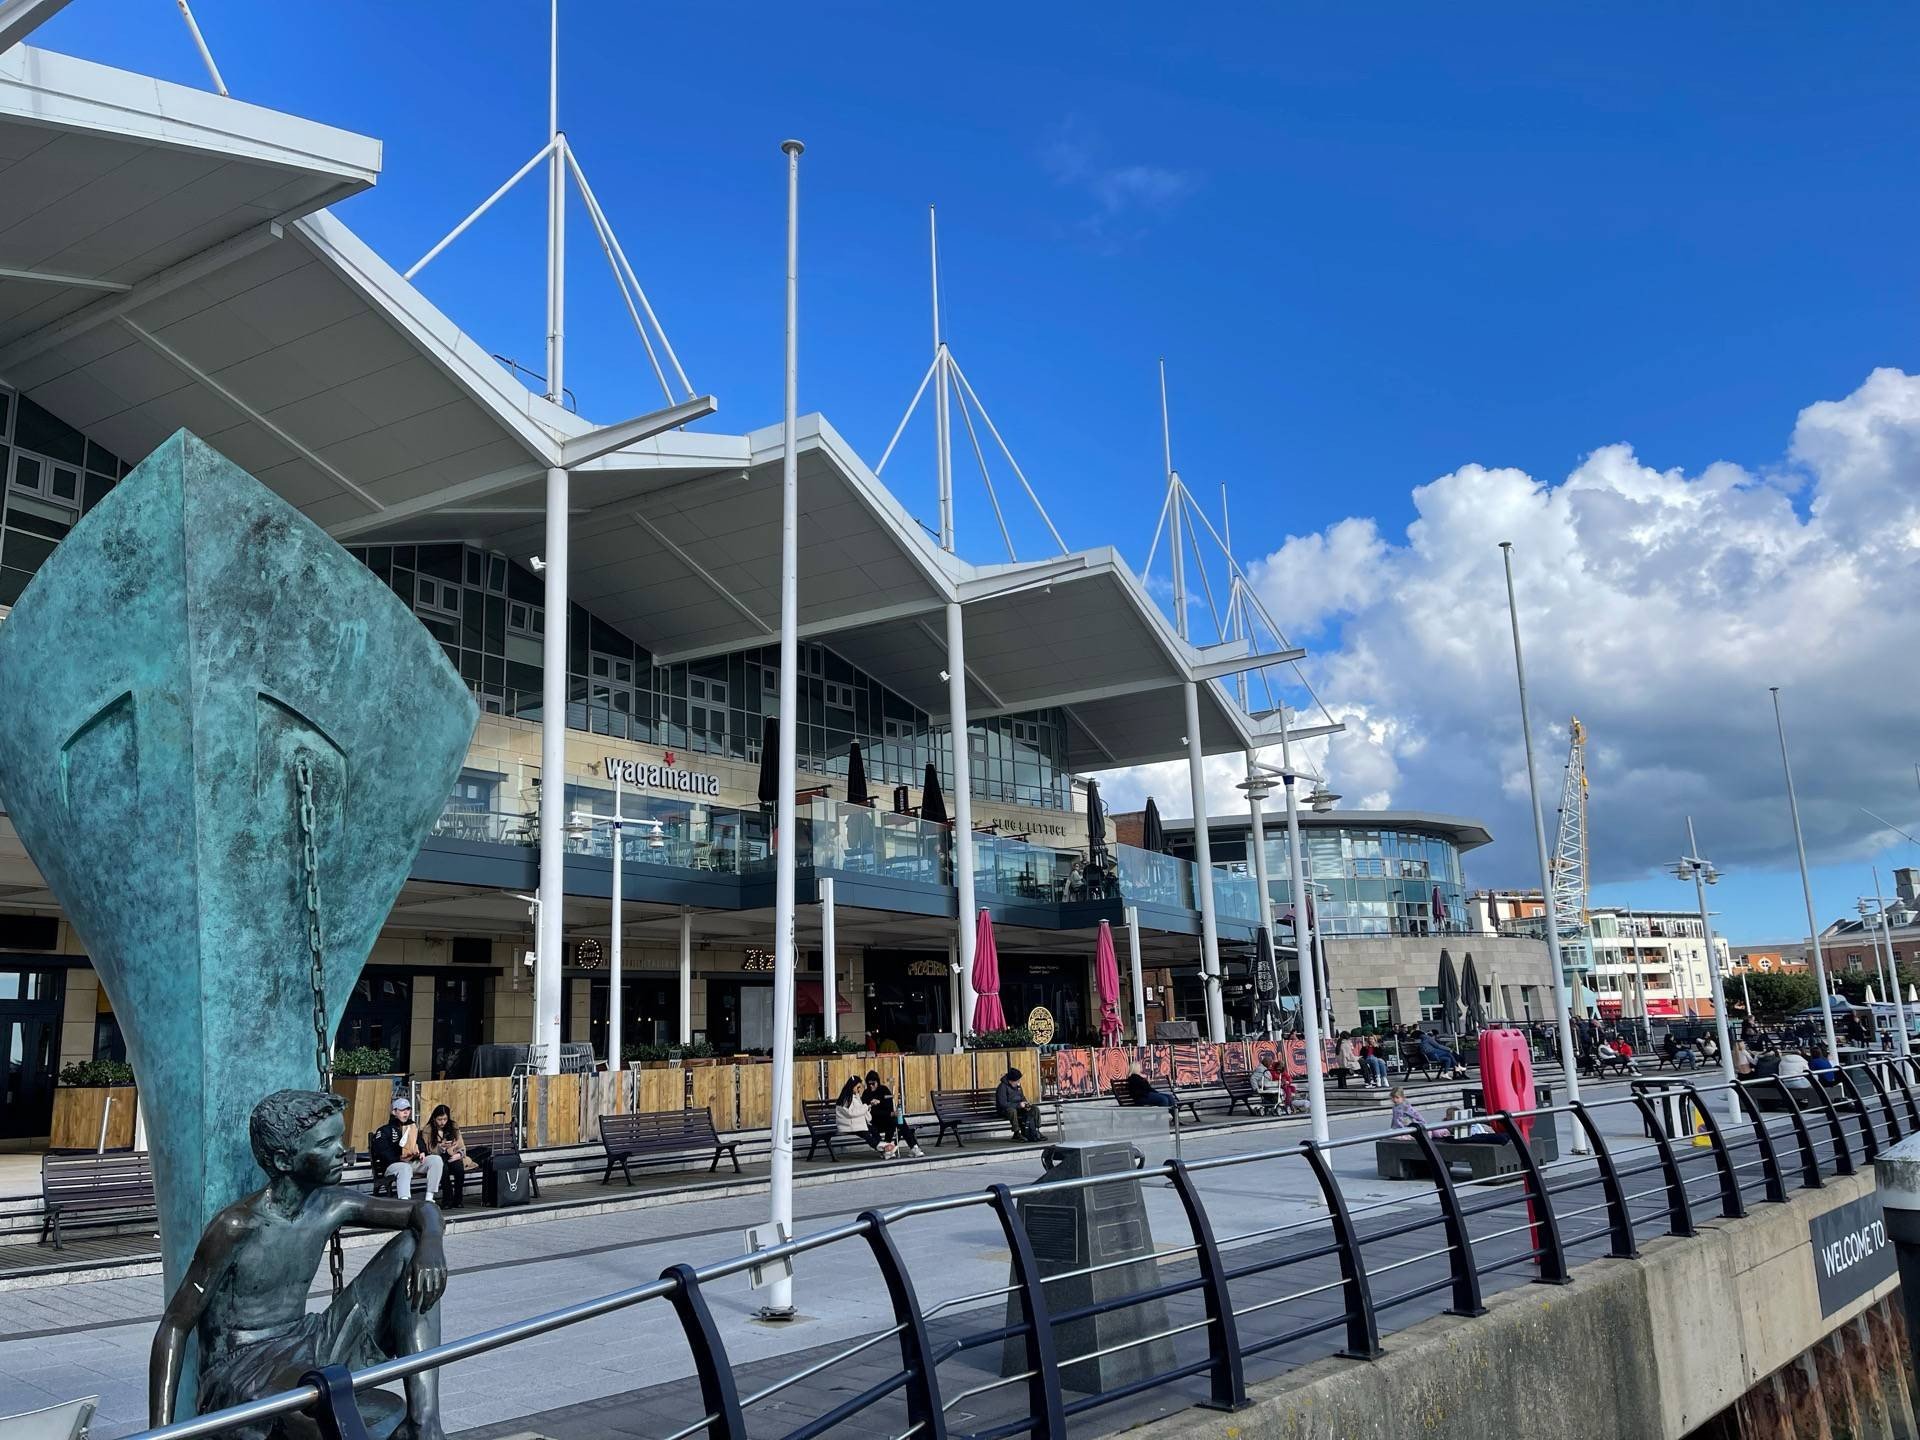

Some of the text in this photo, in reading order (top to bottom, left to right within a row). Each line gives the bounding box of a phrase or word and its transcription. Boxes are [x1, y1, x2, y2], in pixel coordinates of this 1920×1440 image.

[605, 757, 720, 797] wagamama
[992, 818, 1016, 831] SLUG
[1027, 822, 1066, 837] LETTUCE
[744, 949, 776, 970] Ziz
[1822, 1219, 1885, 1278] WELCOME TO
